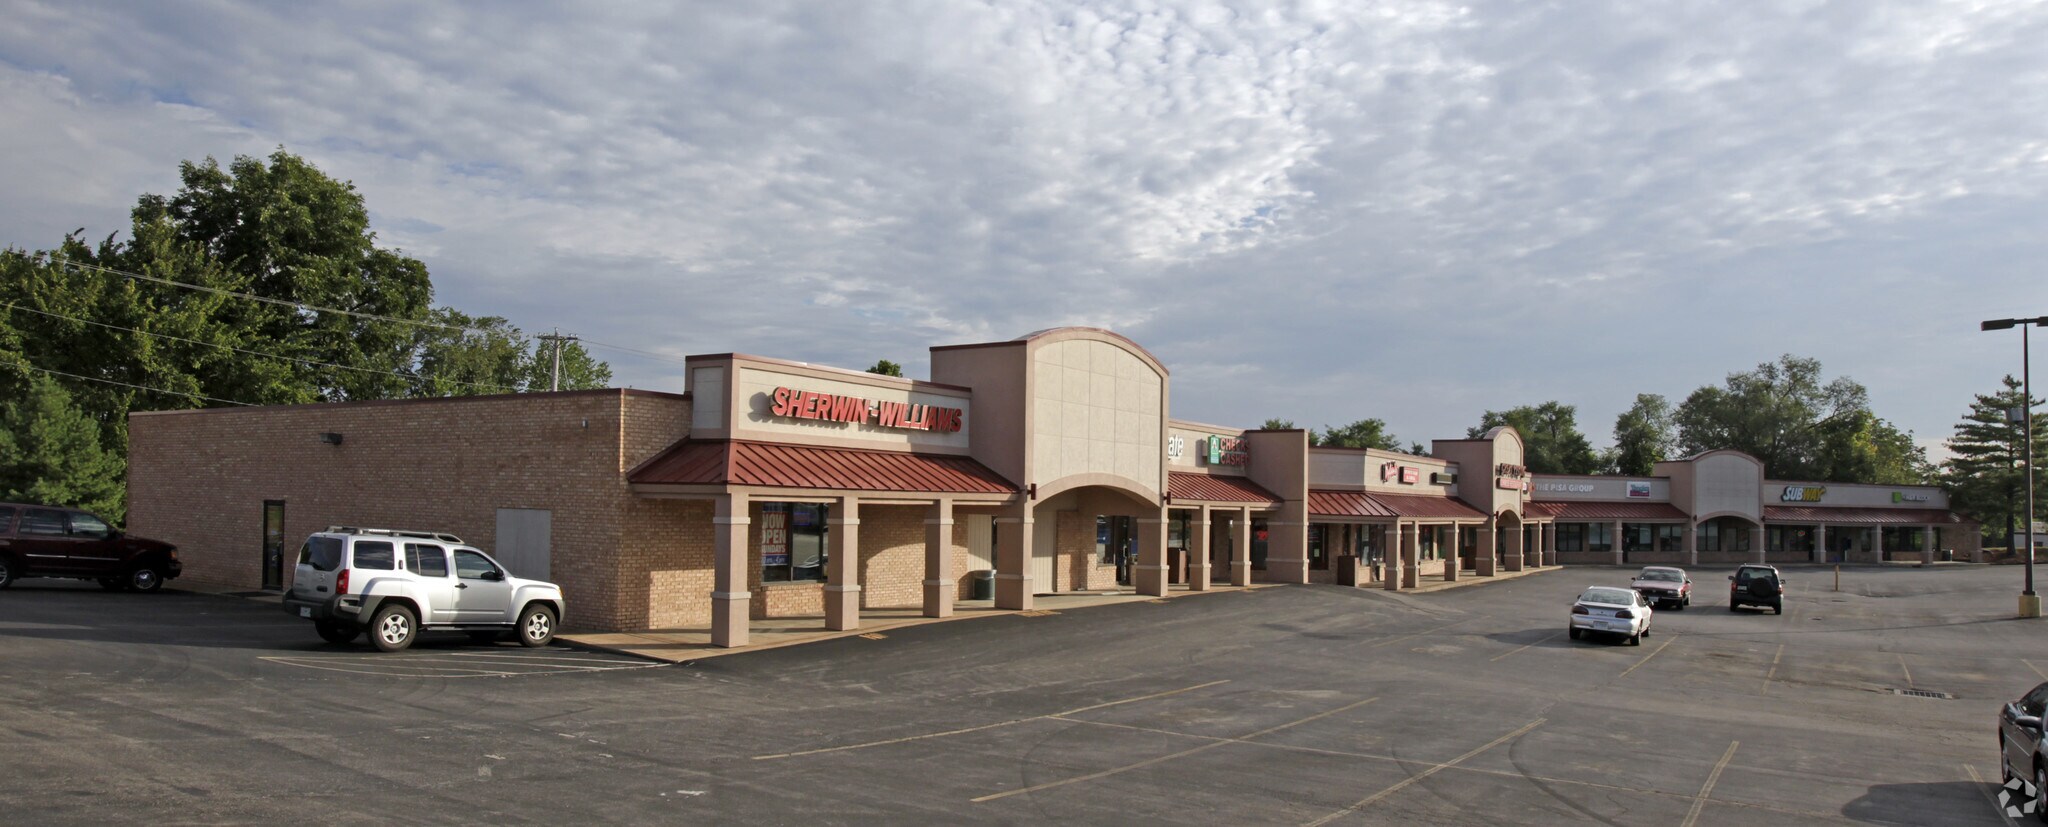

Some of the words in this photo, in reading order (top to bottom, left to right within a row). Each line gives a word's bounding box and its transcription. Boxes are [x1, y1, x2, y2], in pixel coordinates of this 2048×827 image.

[771, 385, 963, 433] SHERWIN-WILLIAMS
[1536, 483, 1549, 491] THE
[1550, 483, 1567, 491] PISA
[1568, 484, 1594, 492] GROUP
[1782, 485, 1826, 502] SUBWAY
[762, 514, 785, 529] NOW
